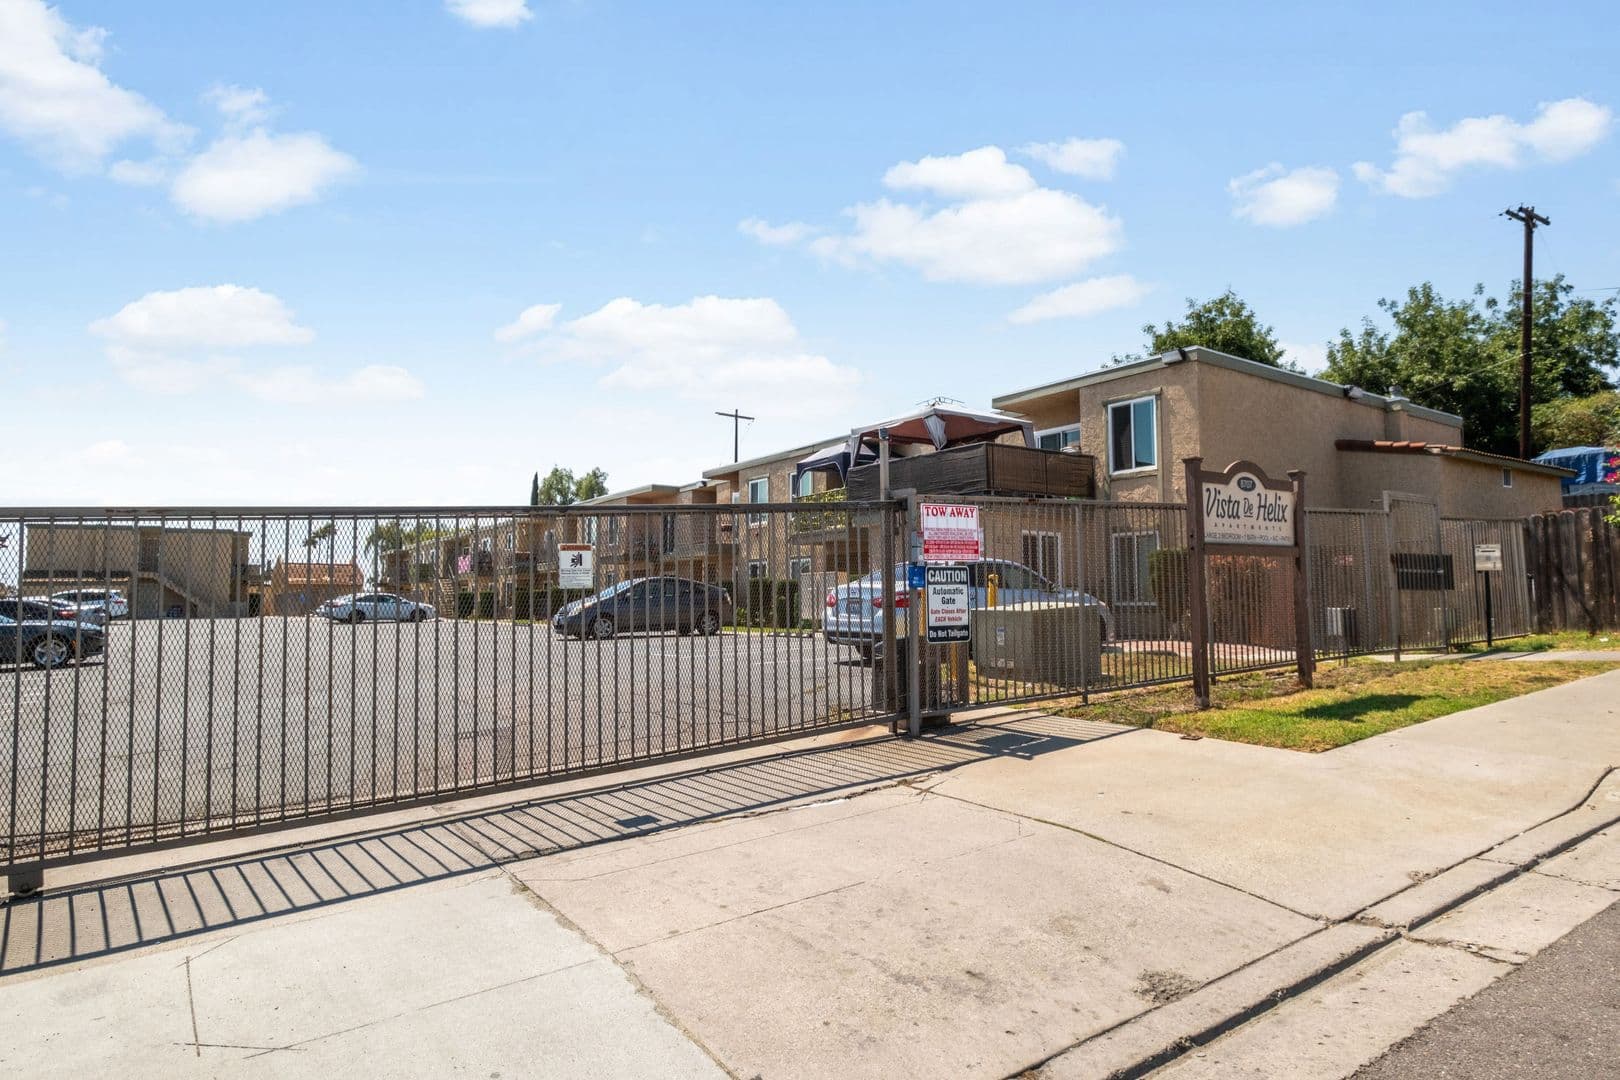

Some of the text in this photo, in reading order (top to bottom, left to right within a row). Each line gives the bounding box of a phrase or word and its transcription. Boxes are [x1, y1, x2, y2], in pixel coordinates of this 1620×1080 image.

[1206, 487, 1288, 523] Vista De Helix
[925, 506, 976, 518] TOW AWAY
[928, 570, 967, 583] CAUTION
[932, 587, 964, 595] Automatic
[941, 596, 956, 605] Gate
[929, 629, 969, 638] Do Not Tailgate
